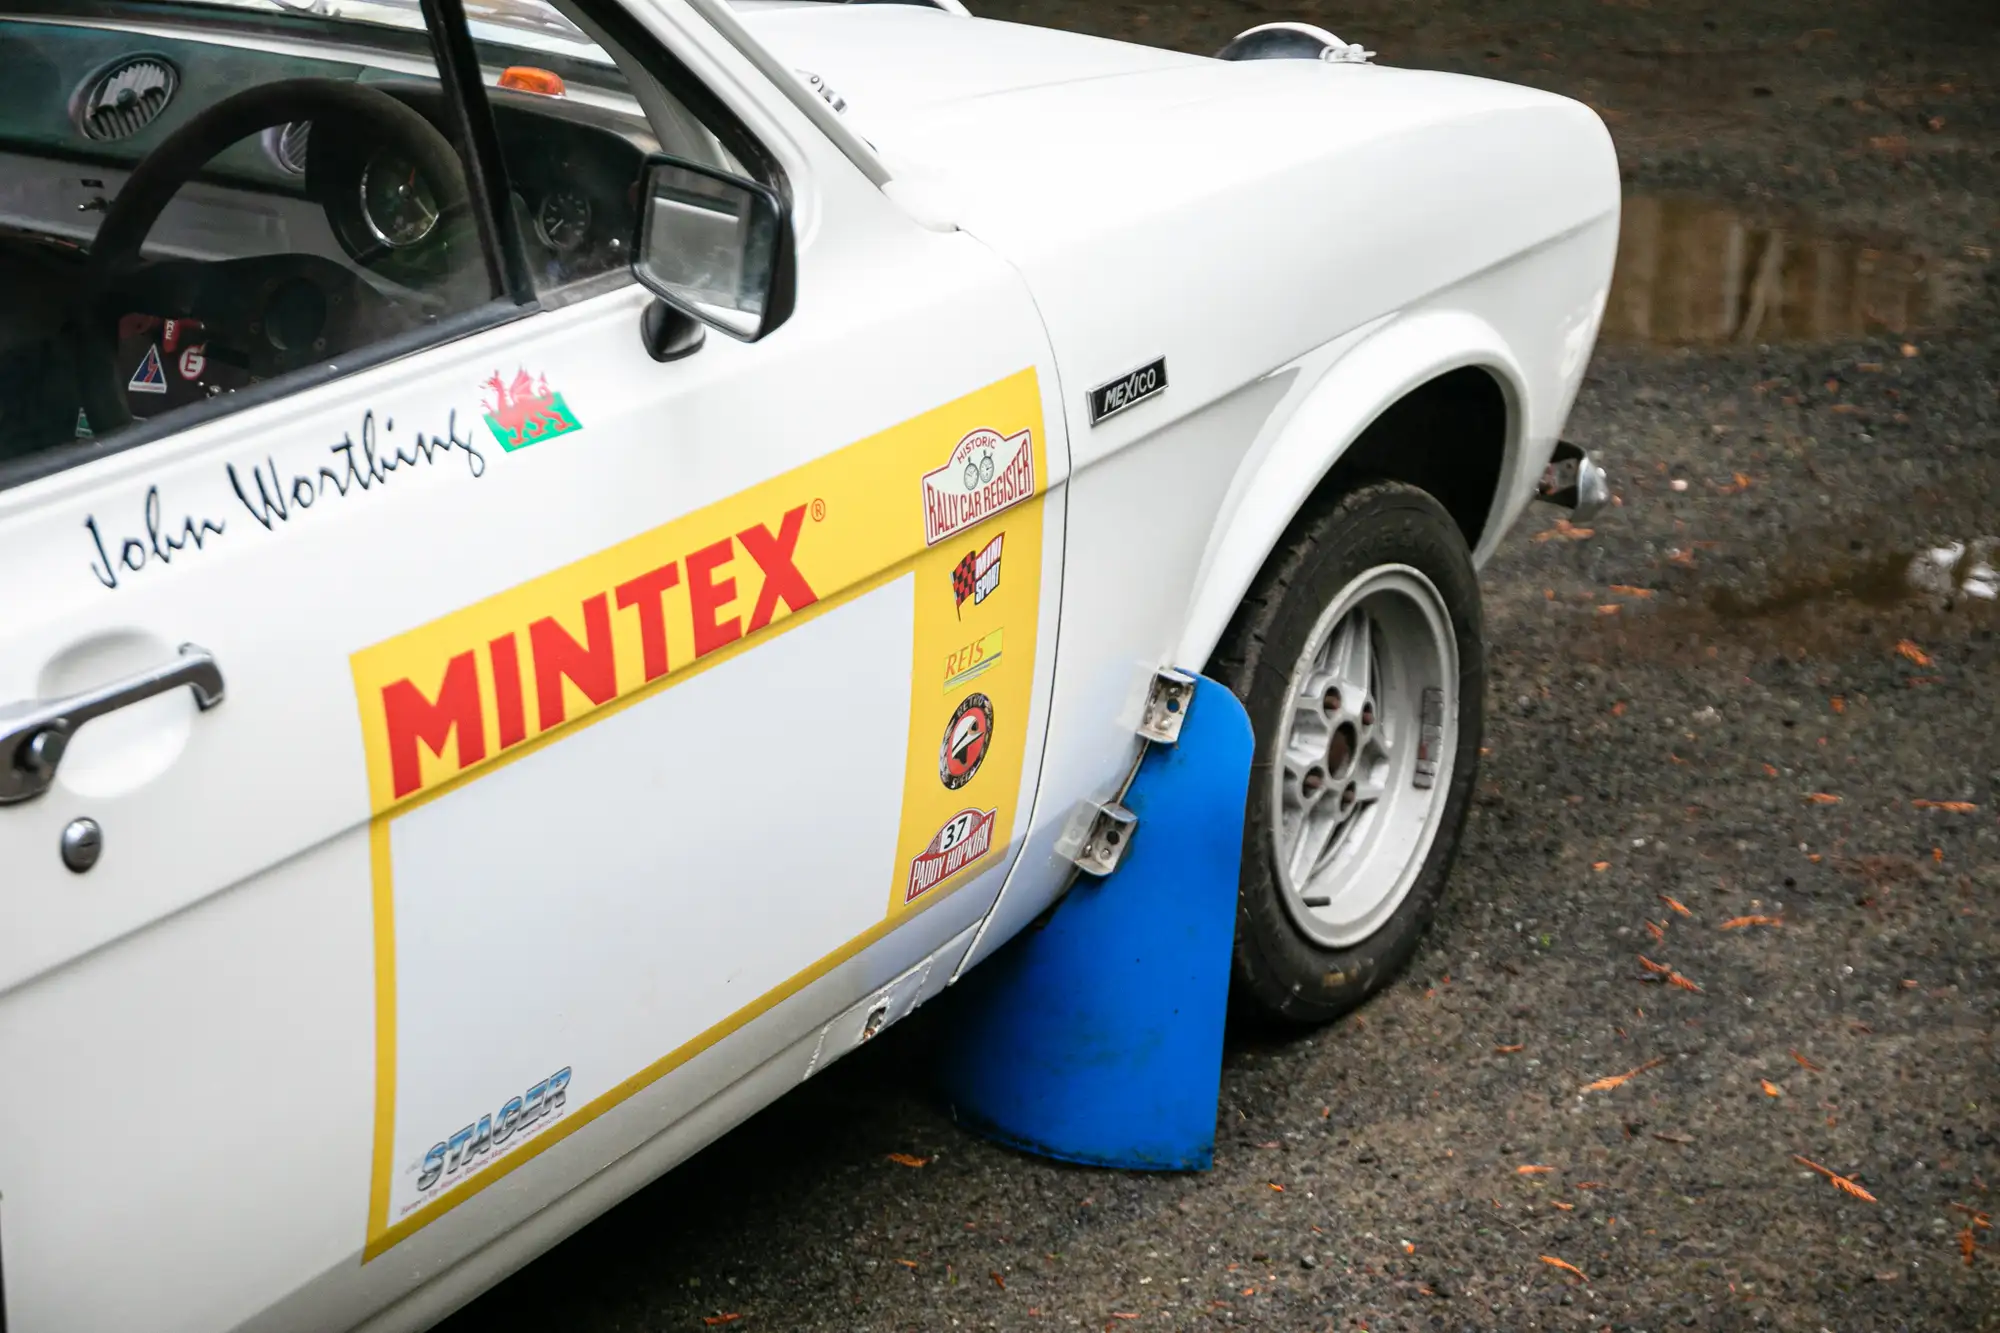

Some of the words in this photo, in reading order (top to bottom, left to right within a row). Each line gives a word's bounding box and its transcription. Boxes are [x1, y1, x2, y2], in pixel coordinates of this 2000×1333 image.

[184, 351, 200, 373] E
[1103, 368, 1156, 412] MEXICO
[957, 435, 997, 464] HISTORIC
[84, 485, 225, 588] John
[226, 408, 485, 531] Worthing
[926, 481, 959, 538] RALLY
[960, 491, 982, 523] CAR
[983, 438, 1031, 513] REGISTER
[975, 535, 1002, 580] MINI
[975, 560, 1000, 603] SPORT
[944, 637, 986, 679] REIS
[943, 815, 968, 850] 37
[910, 855, 946, 896] PADDY
[945, 814, 993, 874] HOPKIRK
[416, 1066, 573, 1191] STAGER
